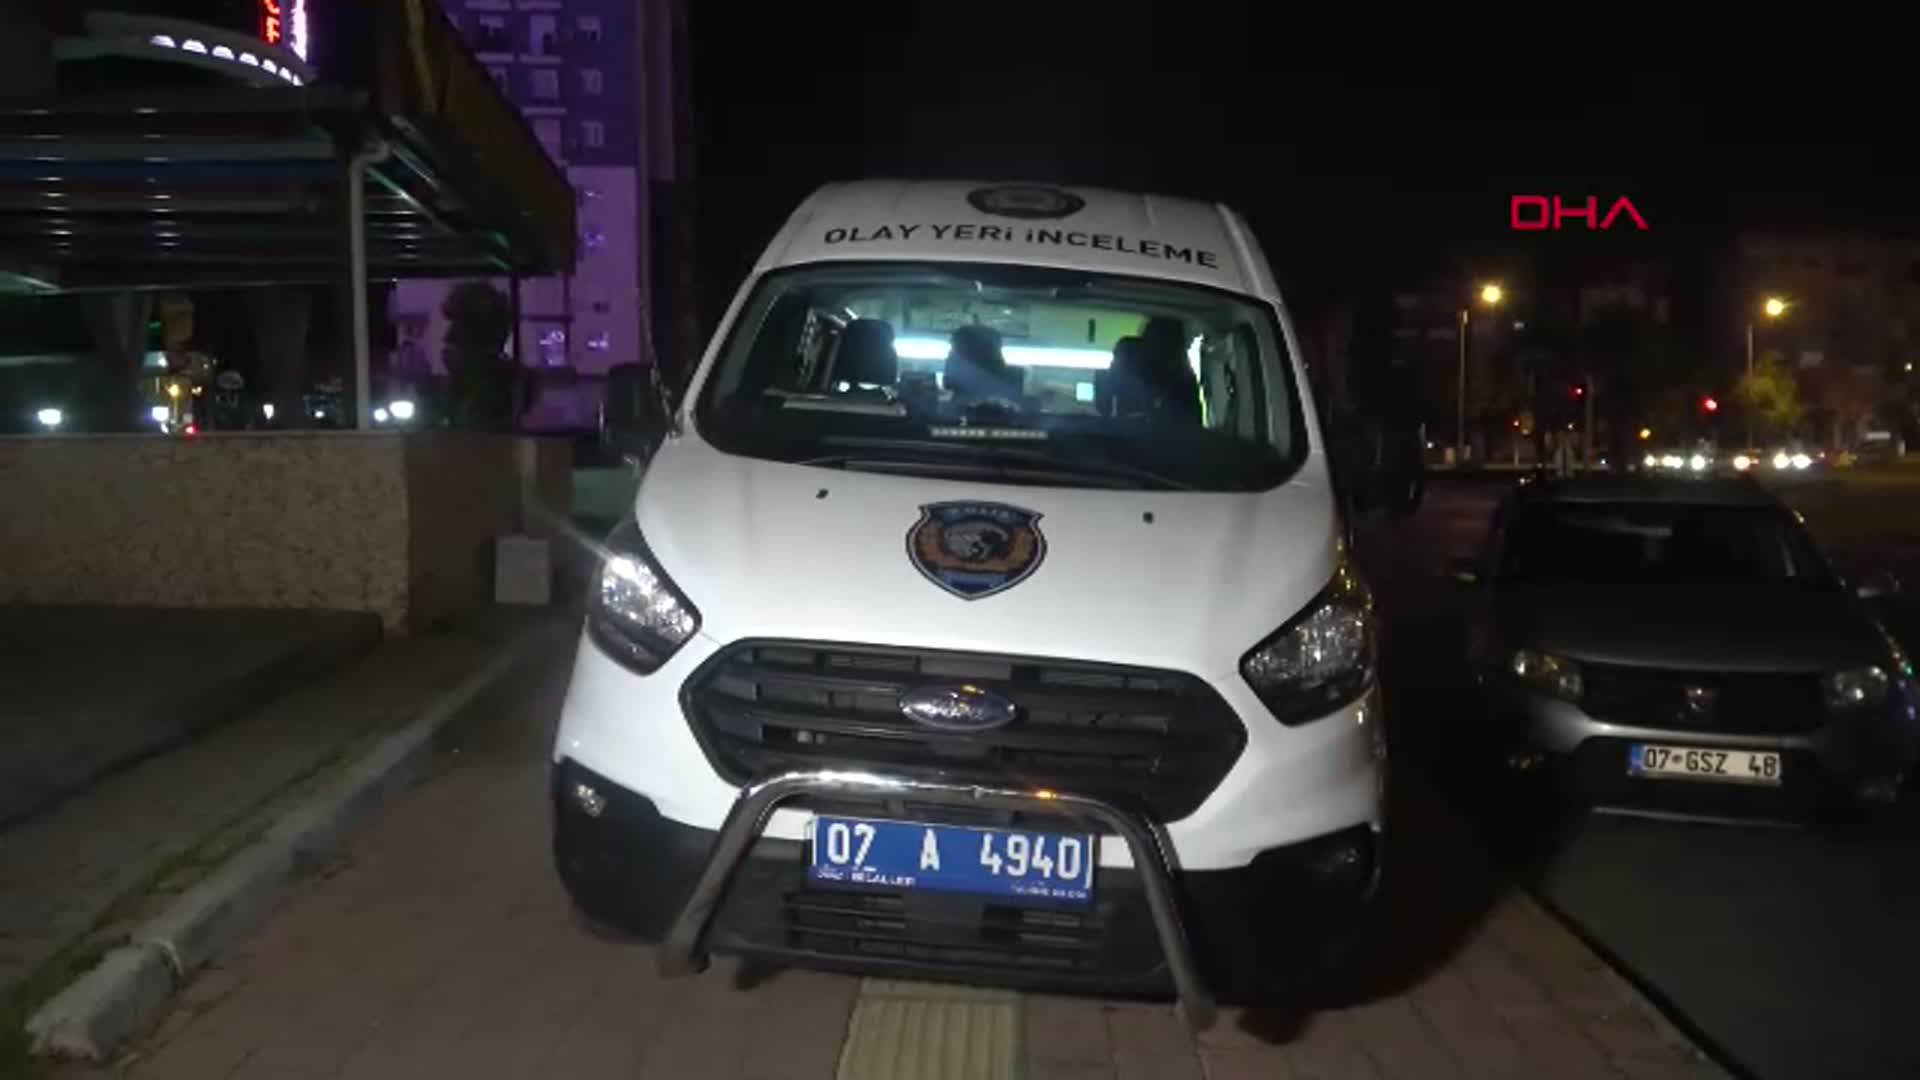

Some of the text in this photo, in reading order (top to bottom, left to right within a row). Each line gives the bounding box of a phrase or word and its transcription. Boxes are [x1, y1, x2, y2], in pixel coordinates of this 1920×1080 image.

[824, 224, 920, 244] OLAY
[1644, 748, 1777, 777] 07 GSZ 48
[827, 823, 1082, 880] 07 A 4940
